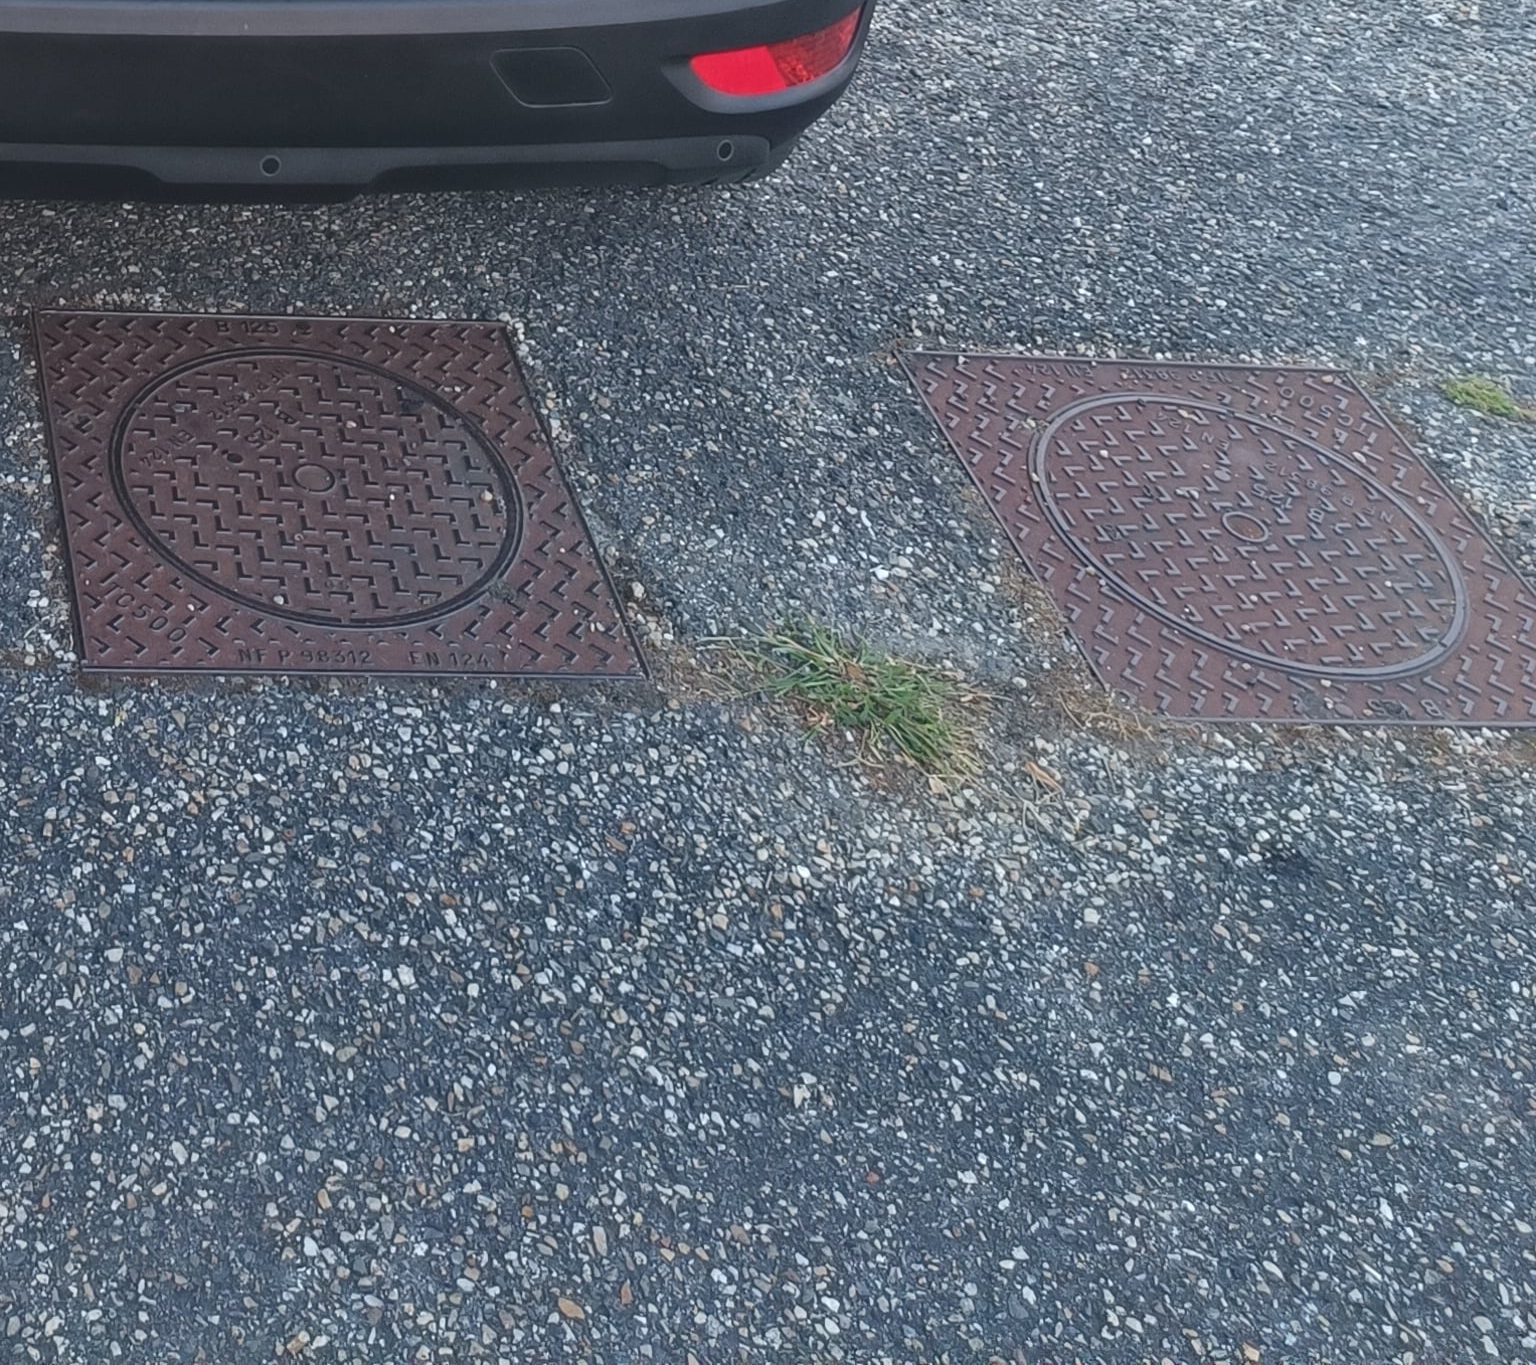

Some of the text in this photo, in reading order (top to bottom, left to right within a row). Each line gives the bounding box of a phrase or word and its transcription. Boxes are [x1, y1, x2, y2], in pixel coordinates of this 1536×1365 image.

[215, 320, 280, 337] B 125
[1279, 386, 1369, 437] TC500
[245, 424, 281, 451] 125
[1202, 431, 1230, 451] EN
[1250, 483, 1325, 524] B 125
[105, 582, 188, 645] TC500
[238, 648, 490, 668] NF P 98312 EN 124
[1420, 698, 1443, 717] B
